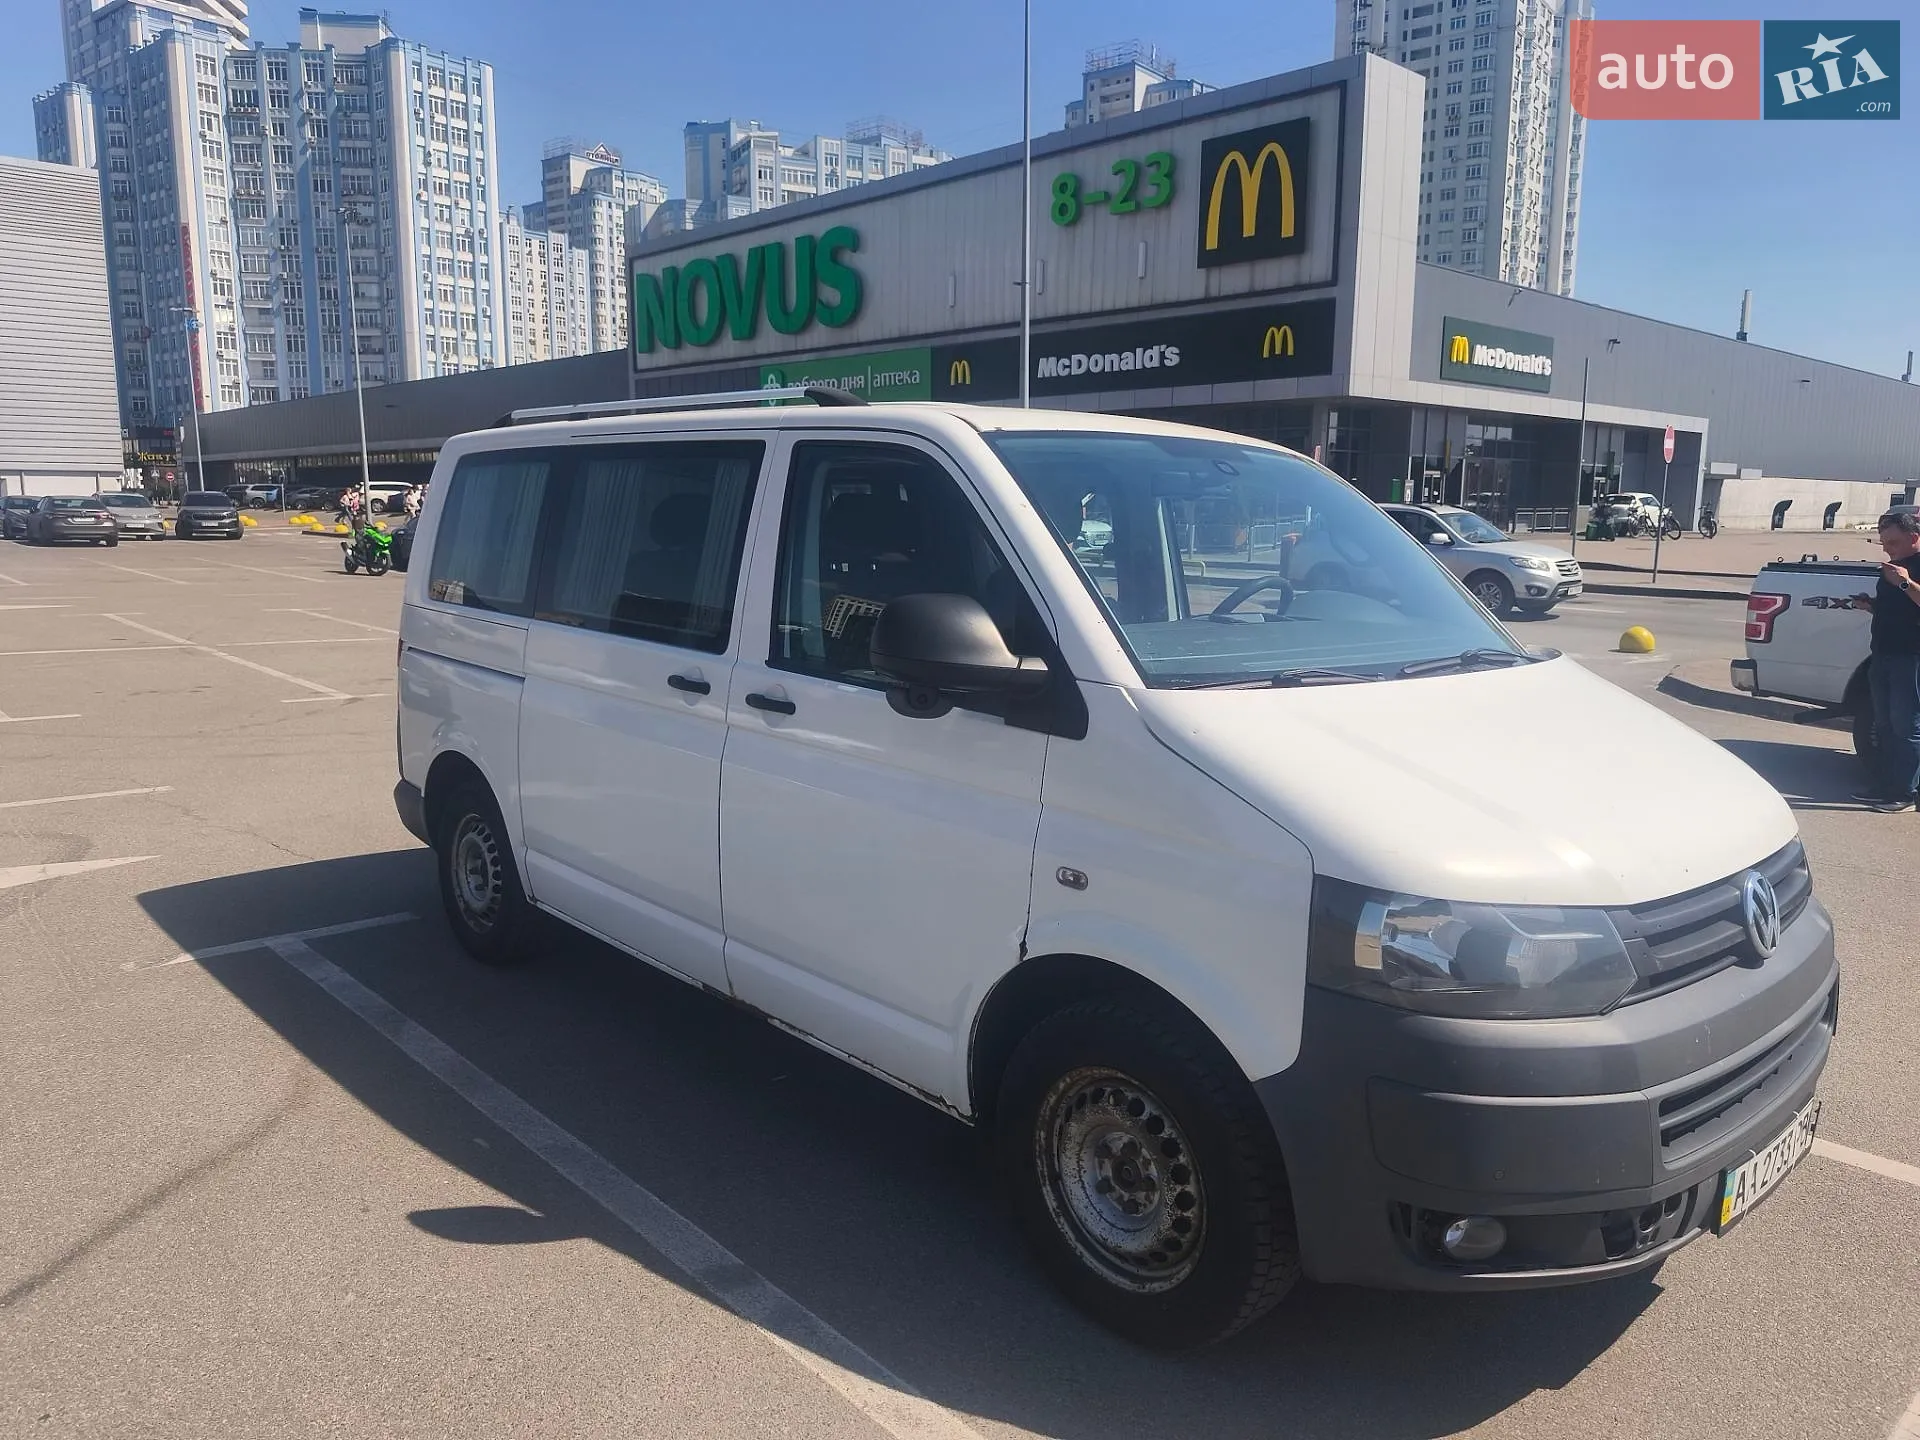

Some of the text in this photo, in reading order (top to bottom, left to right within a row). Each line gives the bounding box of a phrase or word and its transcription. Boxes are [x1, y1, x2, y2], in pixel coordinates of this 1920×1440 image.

[636, 225, 863, 354] NOVUS
[1037, 344, 1181, 379] McDonald's
[1473, 344, 1552, 376] McDonald's
[873, 369, 920, 388] аптека
